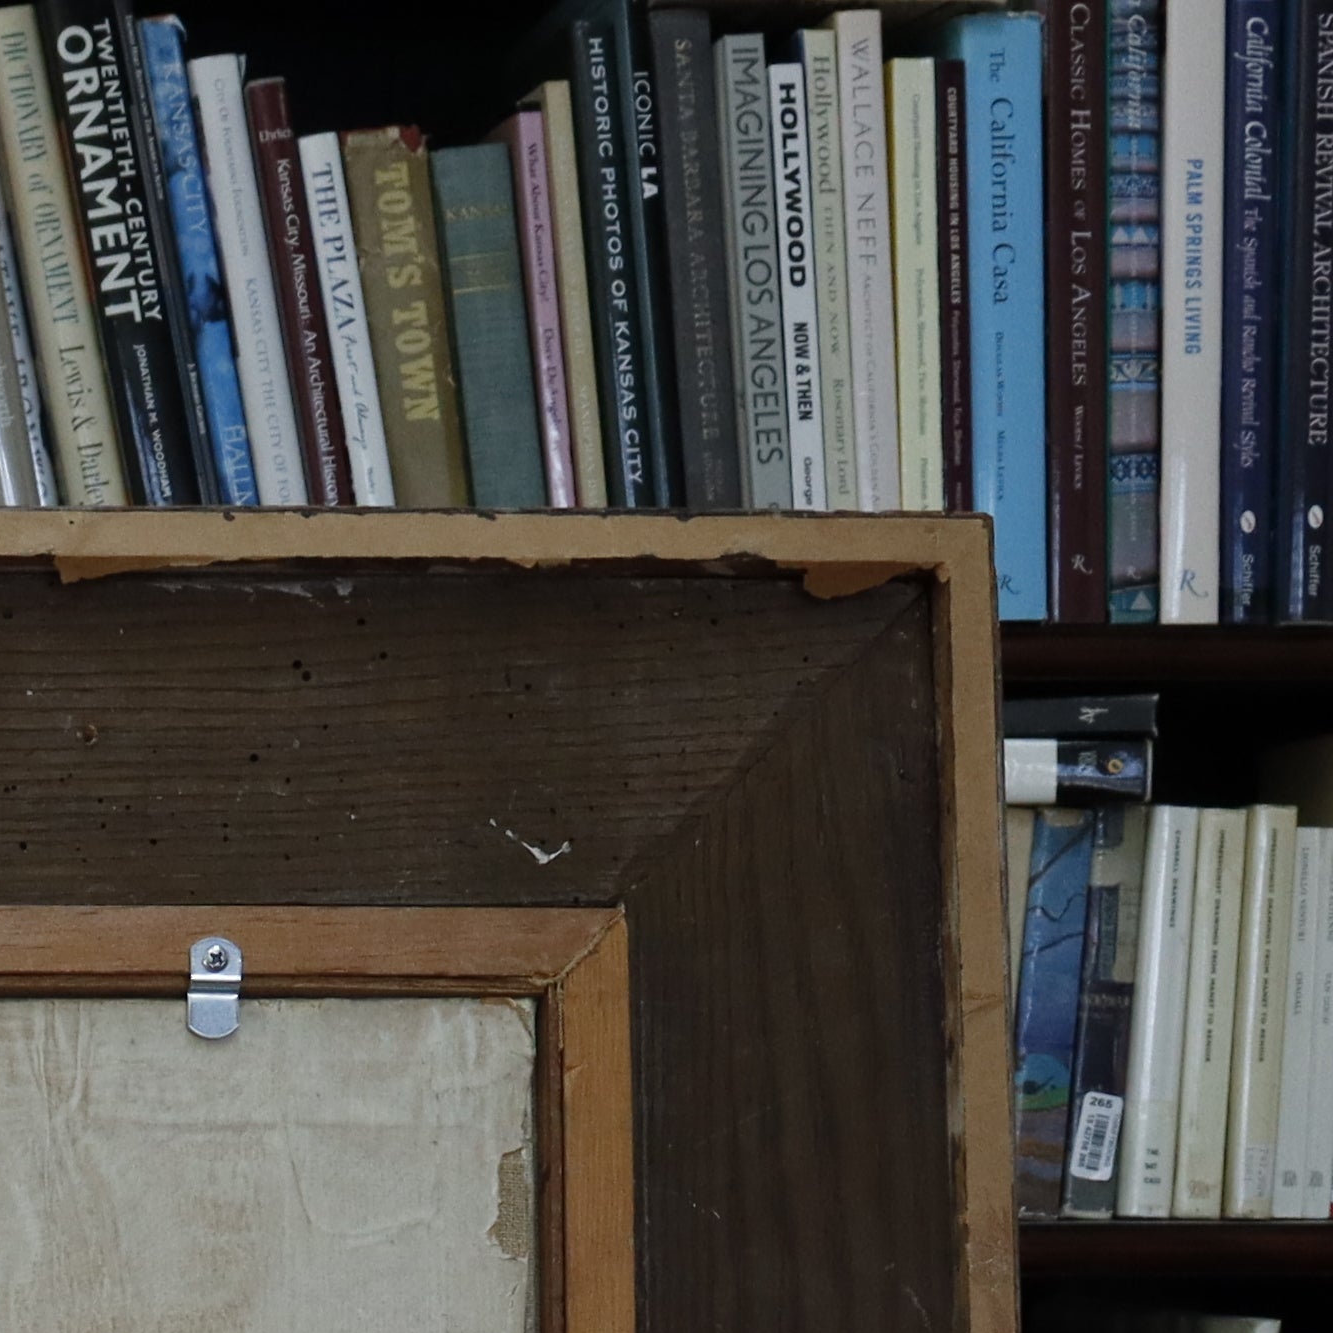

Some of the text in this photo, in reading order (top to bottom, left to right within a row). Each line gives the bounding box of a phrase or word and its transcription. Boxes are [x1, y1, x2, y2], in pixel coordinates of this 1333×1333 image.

[56, 26, 144, 323] ORNAMENT
[163, 63, 209, 235] KANSAS CITY
[633, 71, 659, 200] ICONIC LA
[673, 38, 696, 121] SANTA
[850, 37, 878, 267] WALLACE NEFF
[989, 47, 1017, 305] The California Casa
[1233, 16, 1274, 232] California Colonial The
[312, 163, 357, 331] THE PLAZA
[374, 160, 442, 422] TOM'S TOWN
[588, 36, 644, 484] HISTORIC PHOTOS OF KANSAS CITY
[732, 47, 784, 465] IMAGINING LOS ANGELES
[779, 82, 814, 506] HOLLYWOOD NOW & THEN George
[810, 56, 851, 495] Hollywood Lord
[946, 86, 962, 305] COURTYARD HOUSING IN LOS ANGELES
[1069, 2, 1093, 387] CLASSIC HOMES LOS ANGELES
[1184, 158, 1204, 355] PALM SPRINGS LIVING
[1307, 12, 1333, 446] SPANISH REVIVAL ARCHITECTURE
[59, 344, 94, 409] Lewis
[254, 339, 271, 373] CITY
[260, 379, 277, 410] THE
[276, 158, 335, 452] Kansas An Architectural
[132, 343, 174, 499] JONATHAN WOODHAM
[267, 413, 283, 449] CITY
[272, 454, 287, 474] OF
[1241, 553, 1256, 606] Schiffer
[1308, 544, 1323, 597] Schiffer
